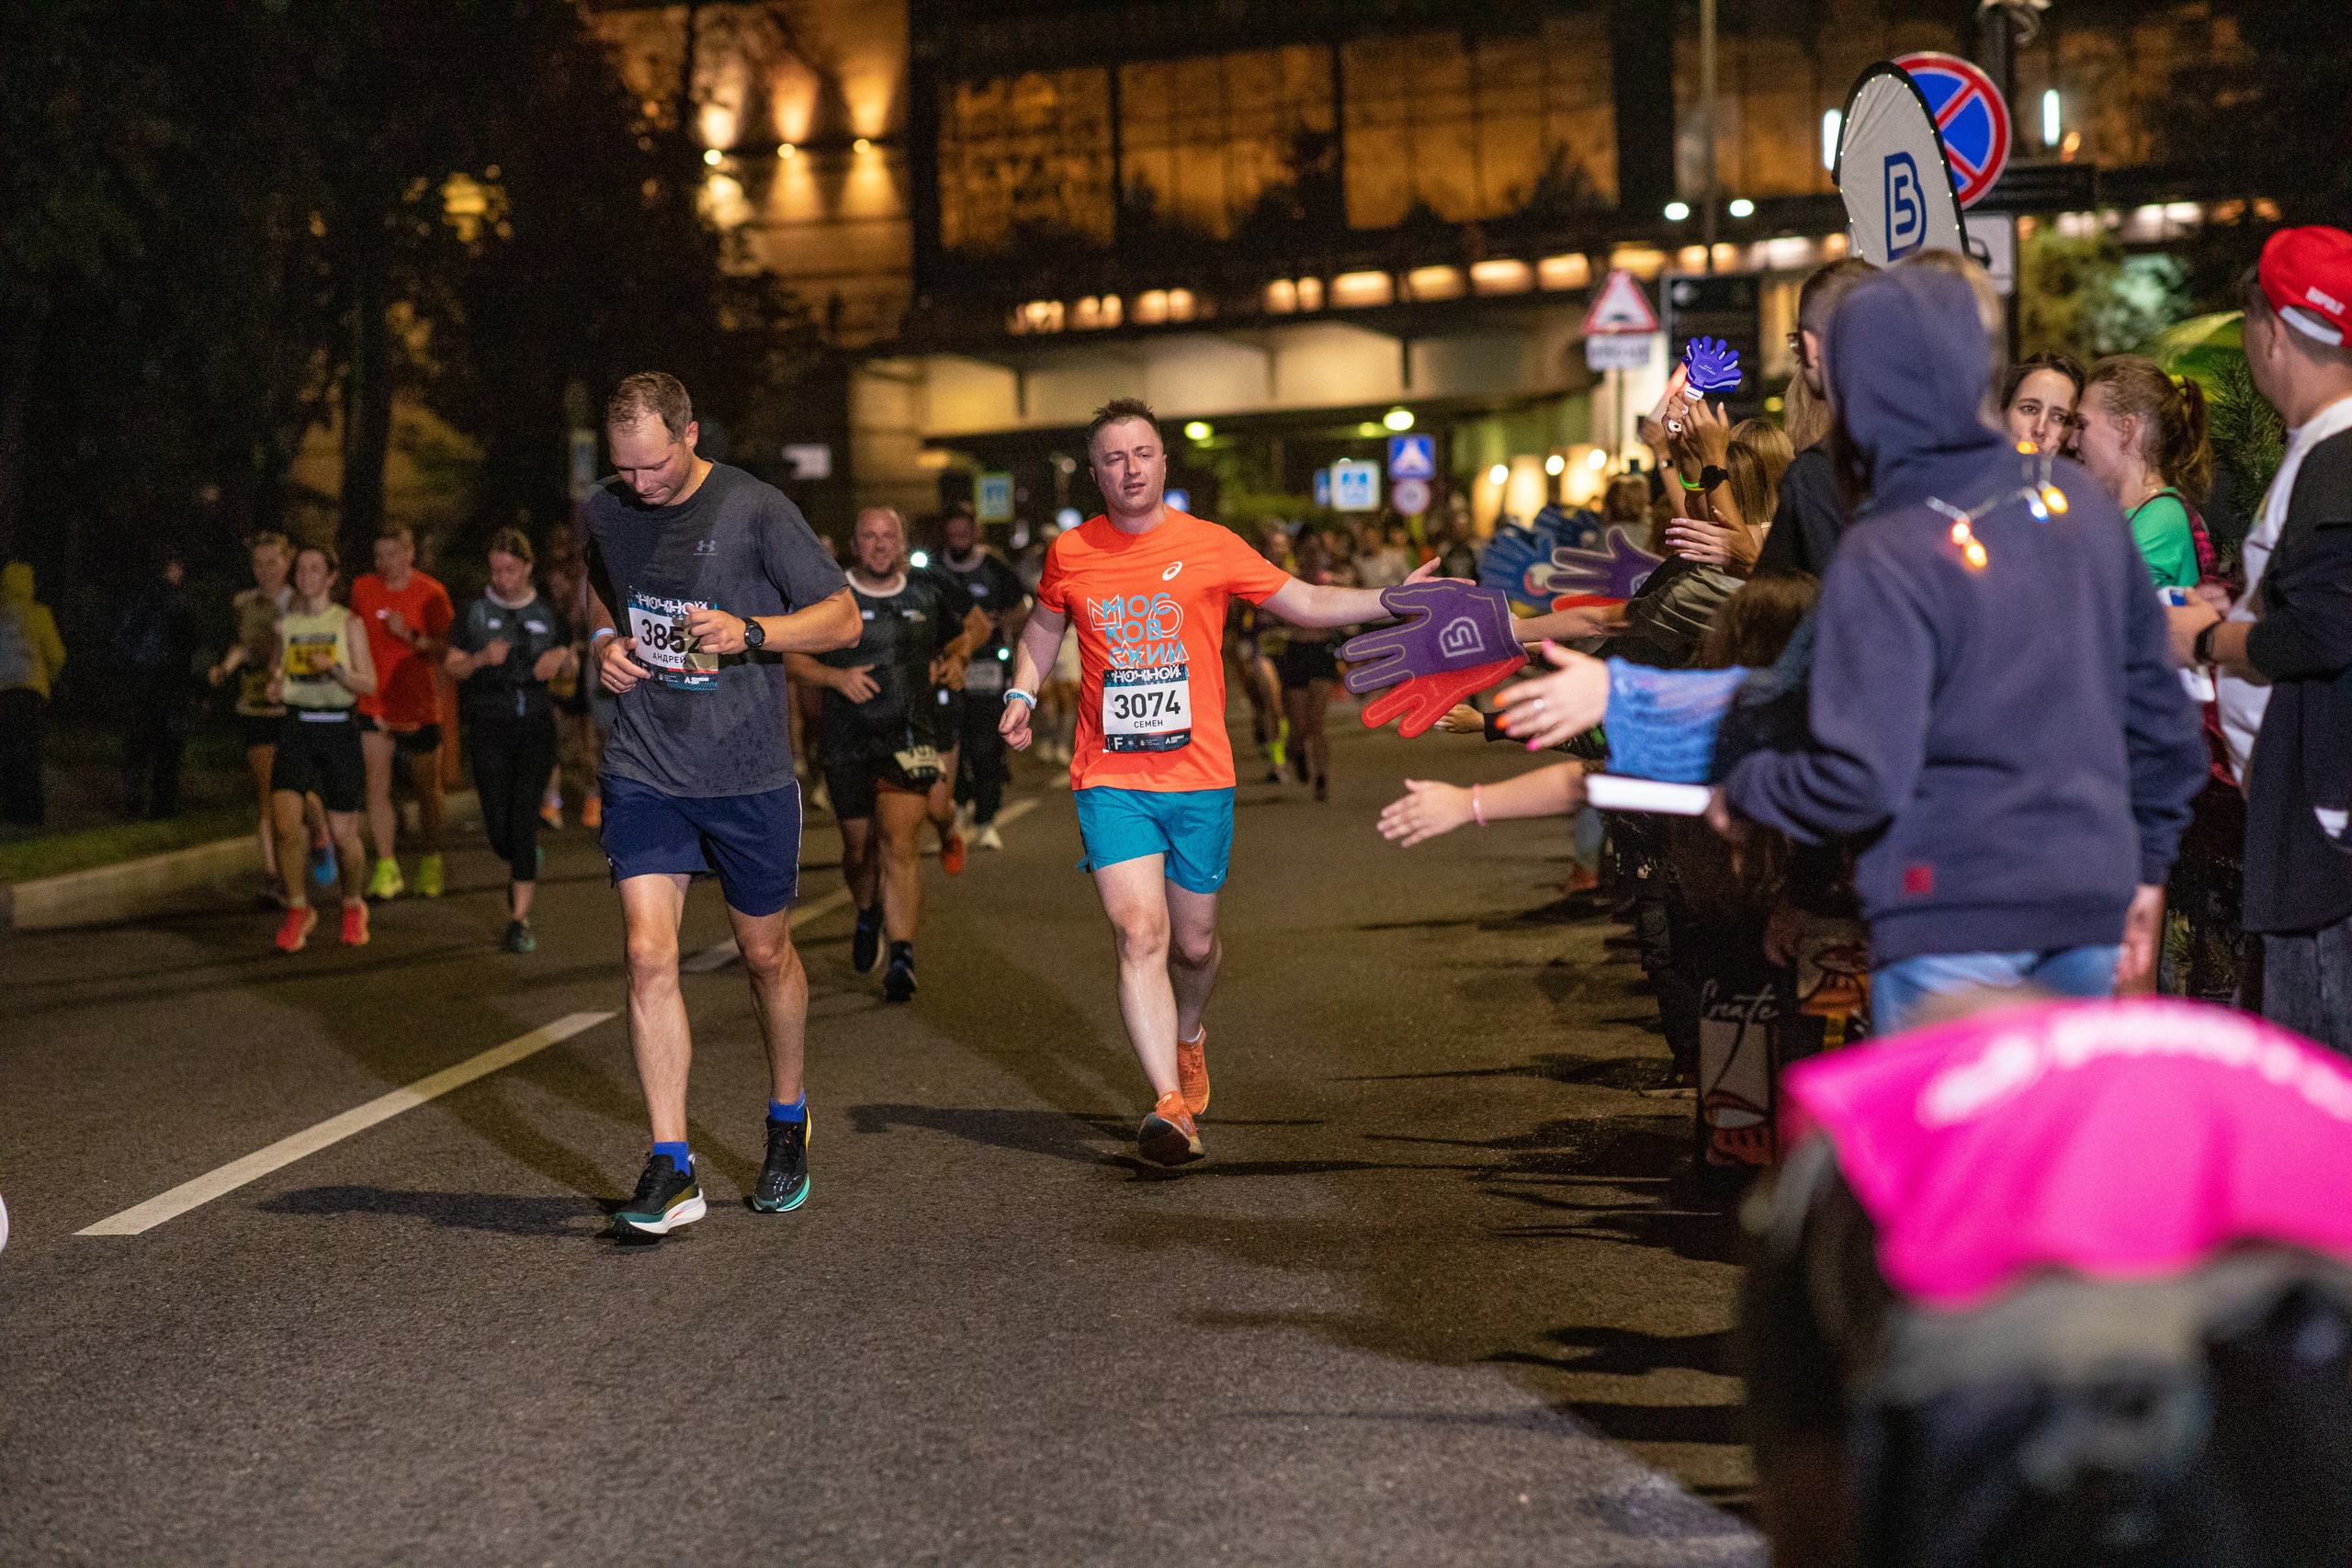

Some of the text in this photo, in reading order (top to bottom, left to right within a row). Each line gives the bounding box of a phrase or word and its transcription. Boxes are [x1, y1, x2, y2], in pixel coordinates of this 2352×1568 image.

[1102, 592, 1171, 620] МОС
[1105, 619, 1162, 644] КОВ
[652, 651, 686, 664] АНДРЕЙ
[1109, 637, 1183, 667] СКИЙ
[1111, 663, 1182, 682] НОЧНОЙ
[1114, 690, 1182, 719] 3074
[1134, 719, 1163, 728] СЕМЕН
[1114, 737, 1123, 751] F
